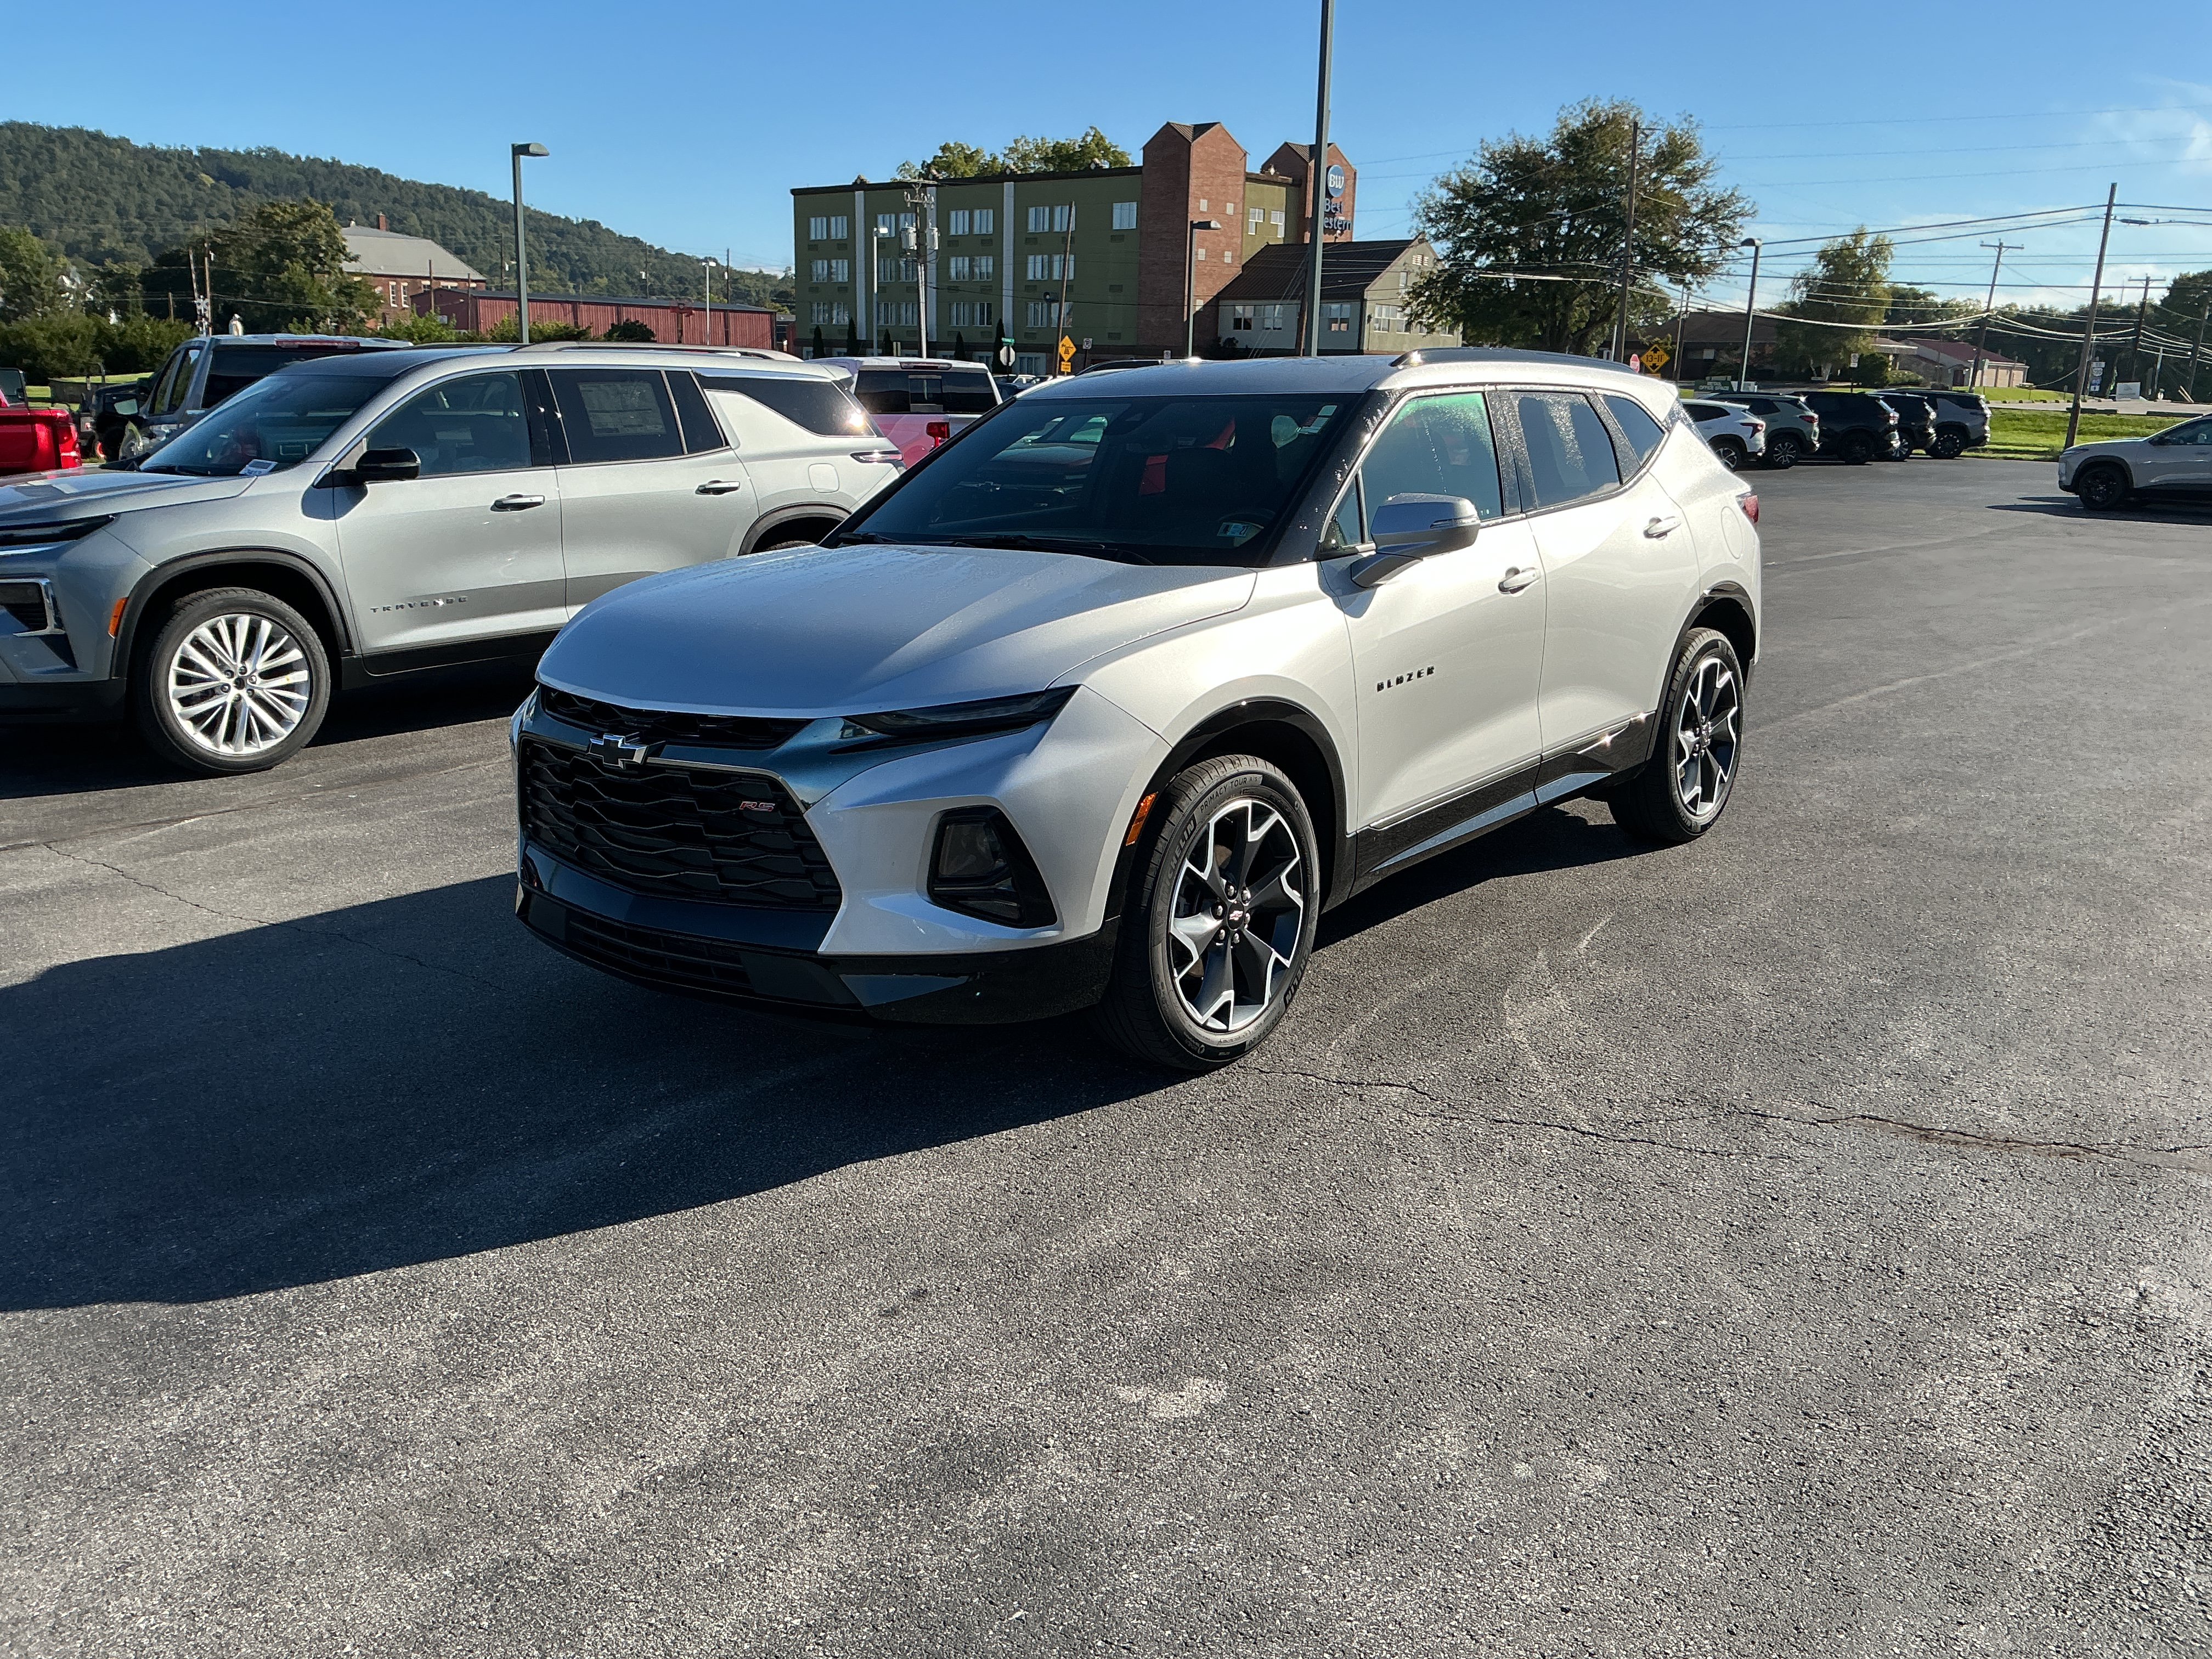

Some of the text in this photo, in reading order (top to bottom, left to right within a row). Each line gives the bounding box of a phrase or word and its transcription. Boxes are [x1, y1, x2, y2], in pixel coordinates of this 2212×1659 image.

[1329, 174, 1345, 189] BW
[1324, 198, 1344, 214] Best
[1323, 216, 1352, 231] estern
[1376, 665, 1435, 693] BLAZER
[1199, 783, 1228, 813] PRIMACY
[1229, 776, 1248, 789] TOUR
[738, 801, 776, 812] RS
